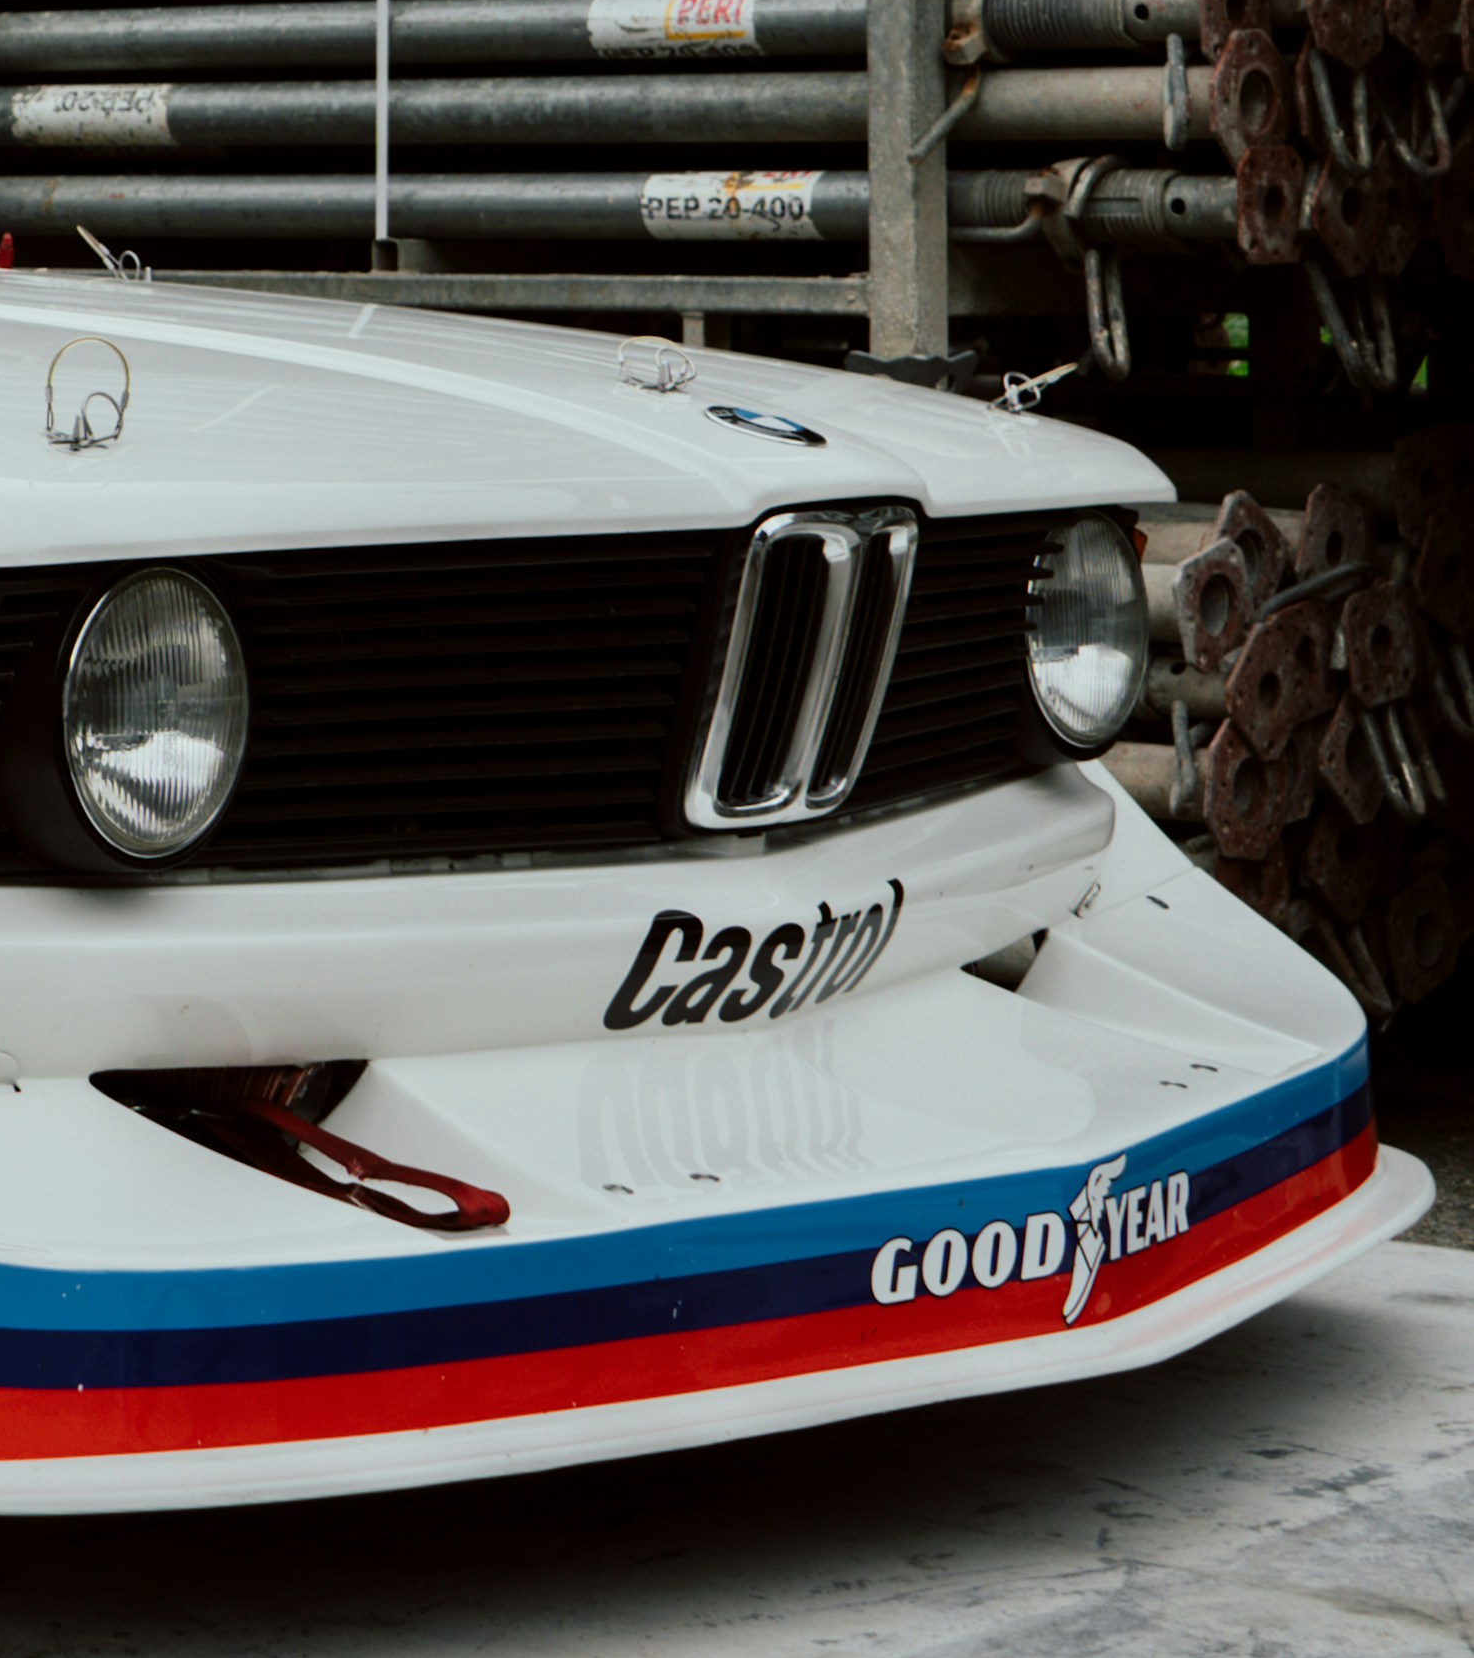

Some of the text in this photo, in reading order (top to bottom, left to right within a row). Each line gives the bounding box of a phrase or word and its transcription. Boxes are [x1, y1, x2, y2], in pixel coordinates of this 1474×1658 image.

[646, 195, 805, 221] PEP 20-400
[603, 878, 905, 1030] Castrol
[869, 1170, 1191, 1306] GOODYEAR
